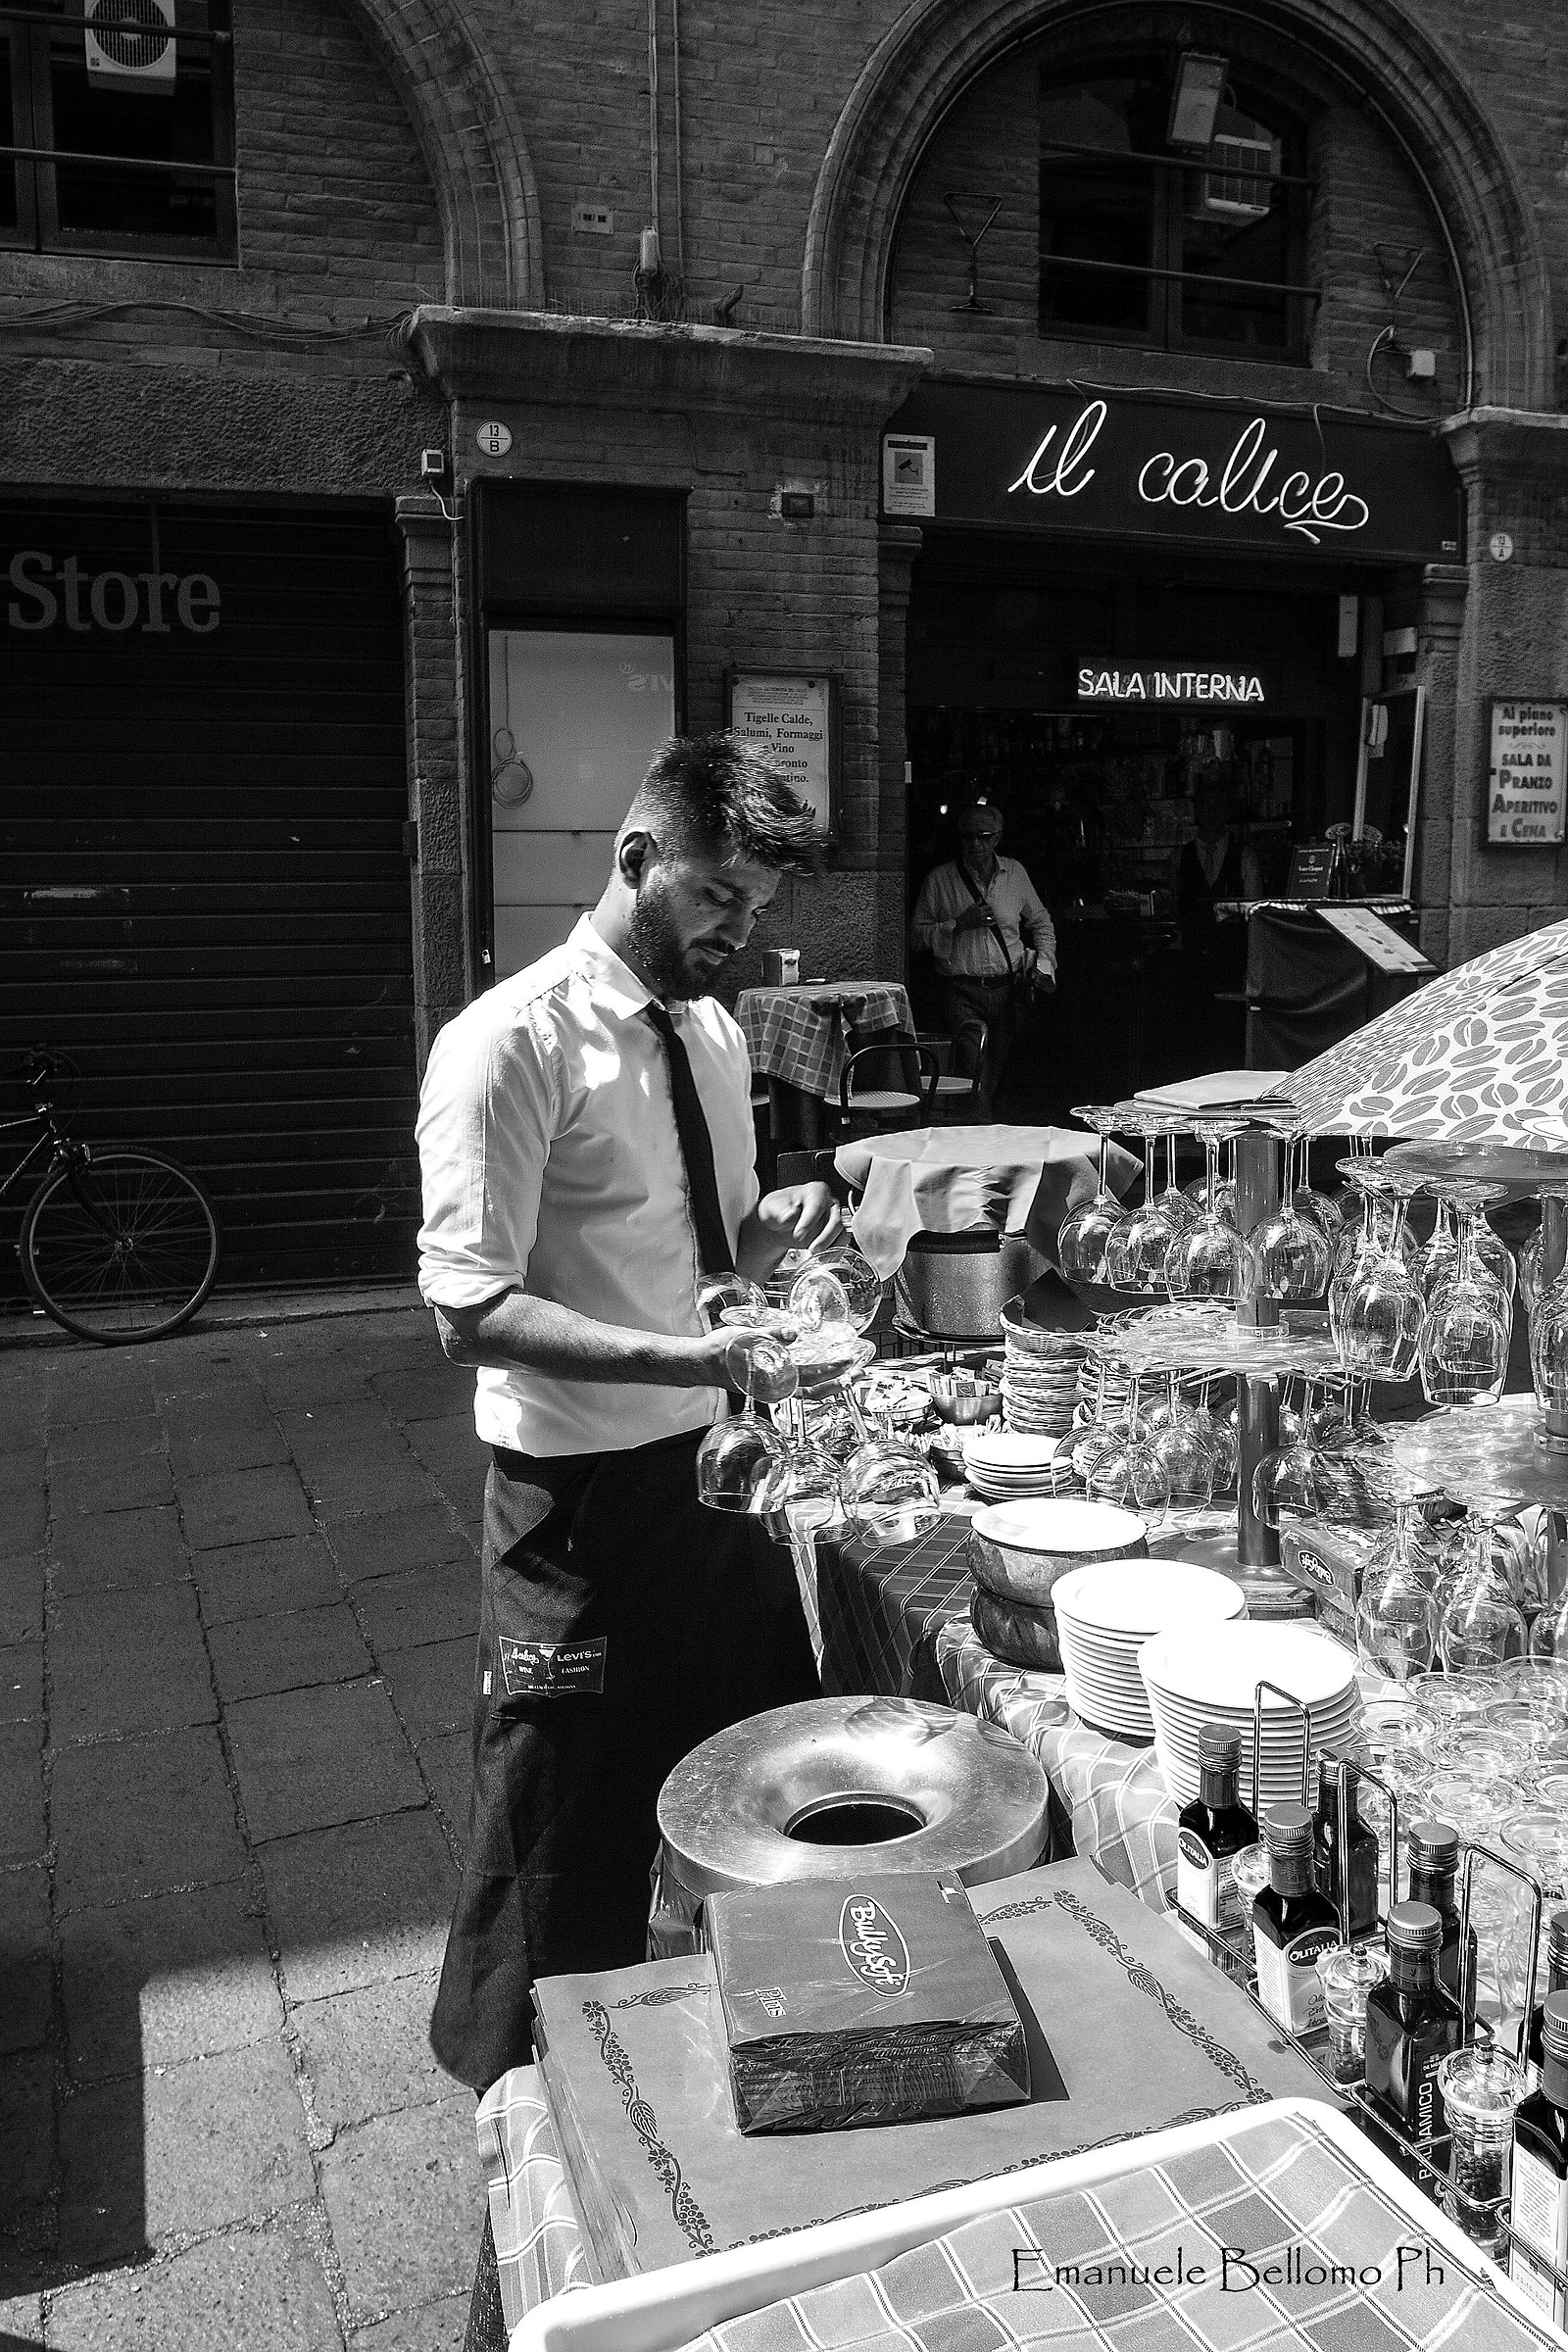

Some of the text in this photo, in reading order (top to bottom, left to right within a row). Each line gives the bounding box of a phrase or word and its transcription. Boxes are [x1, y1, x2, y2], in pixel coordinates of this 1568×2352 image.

[488, 424, 500, 437] 13
[489, 441, 500, 453] B
[1137, 416, 1370, 545] calice
[8, 551, 221, 633] Store
[1077, 667, 1265, 703] SALA INTERNA
[744, 711, 813, 727] Tigelle Calde,
[1502, 707, 1554, 723] Al piano
[733, 726, 824, 742] Salumi, Formaggi
[1497, 722, 1556, 738] superiore
[770, 743, 795, 753] Vino
[781, 759, 808, 768] ronto
[1501, 753, 1552, 766] SALA DA
[562, 1664, 590, 1675] FASHION
[1178, 1837, 1208, 1868] OLITALIA
[849, 1901, 905, 1988] BulkySoft
[1290, 1939, 1340, 1962] OLITALIA
[755, 1985, 787, 2018] Plus
[1417, 2082, 1434, 2180] BLAMICO
